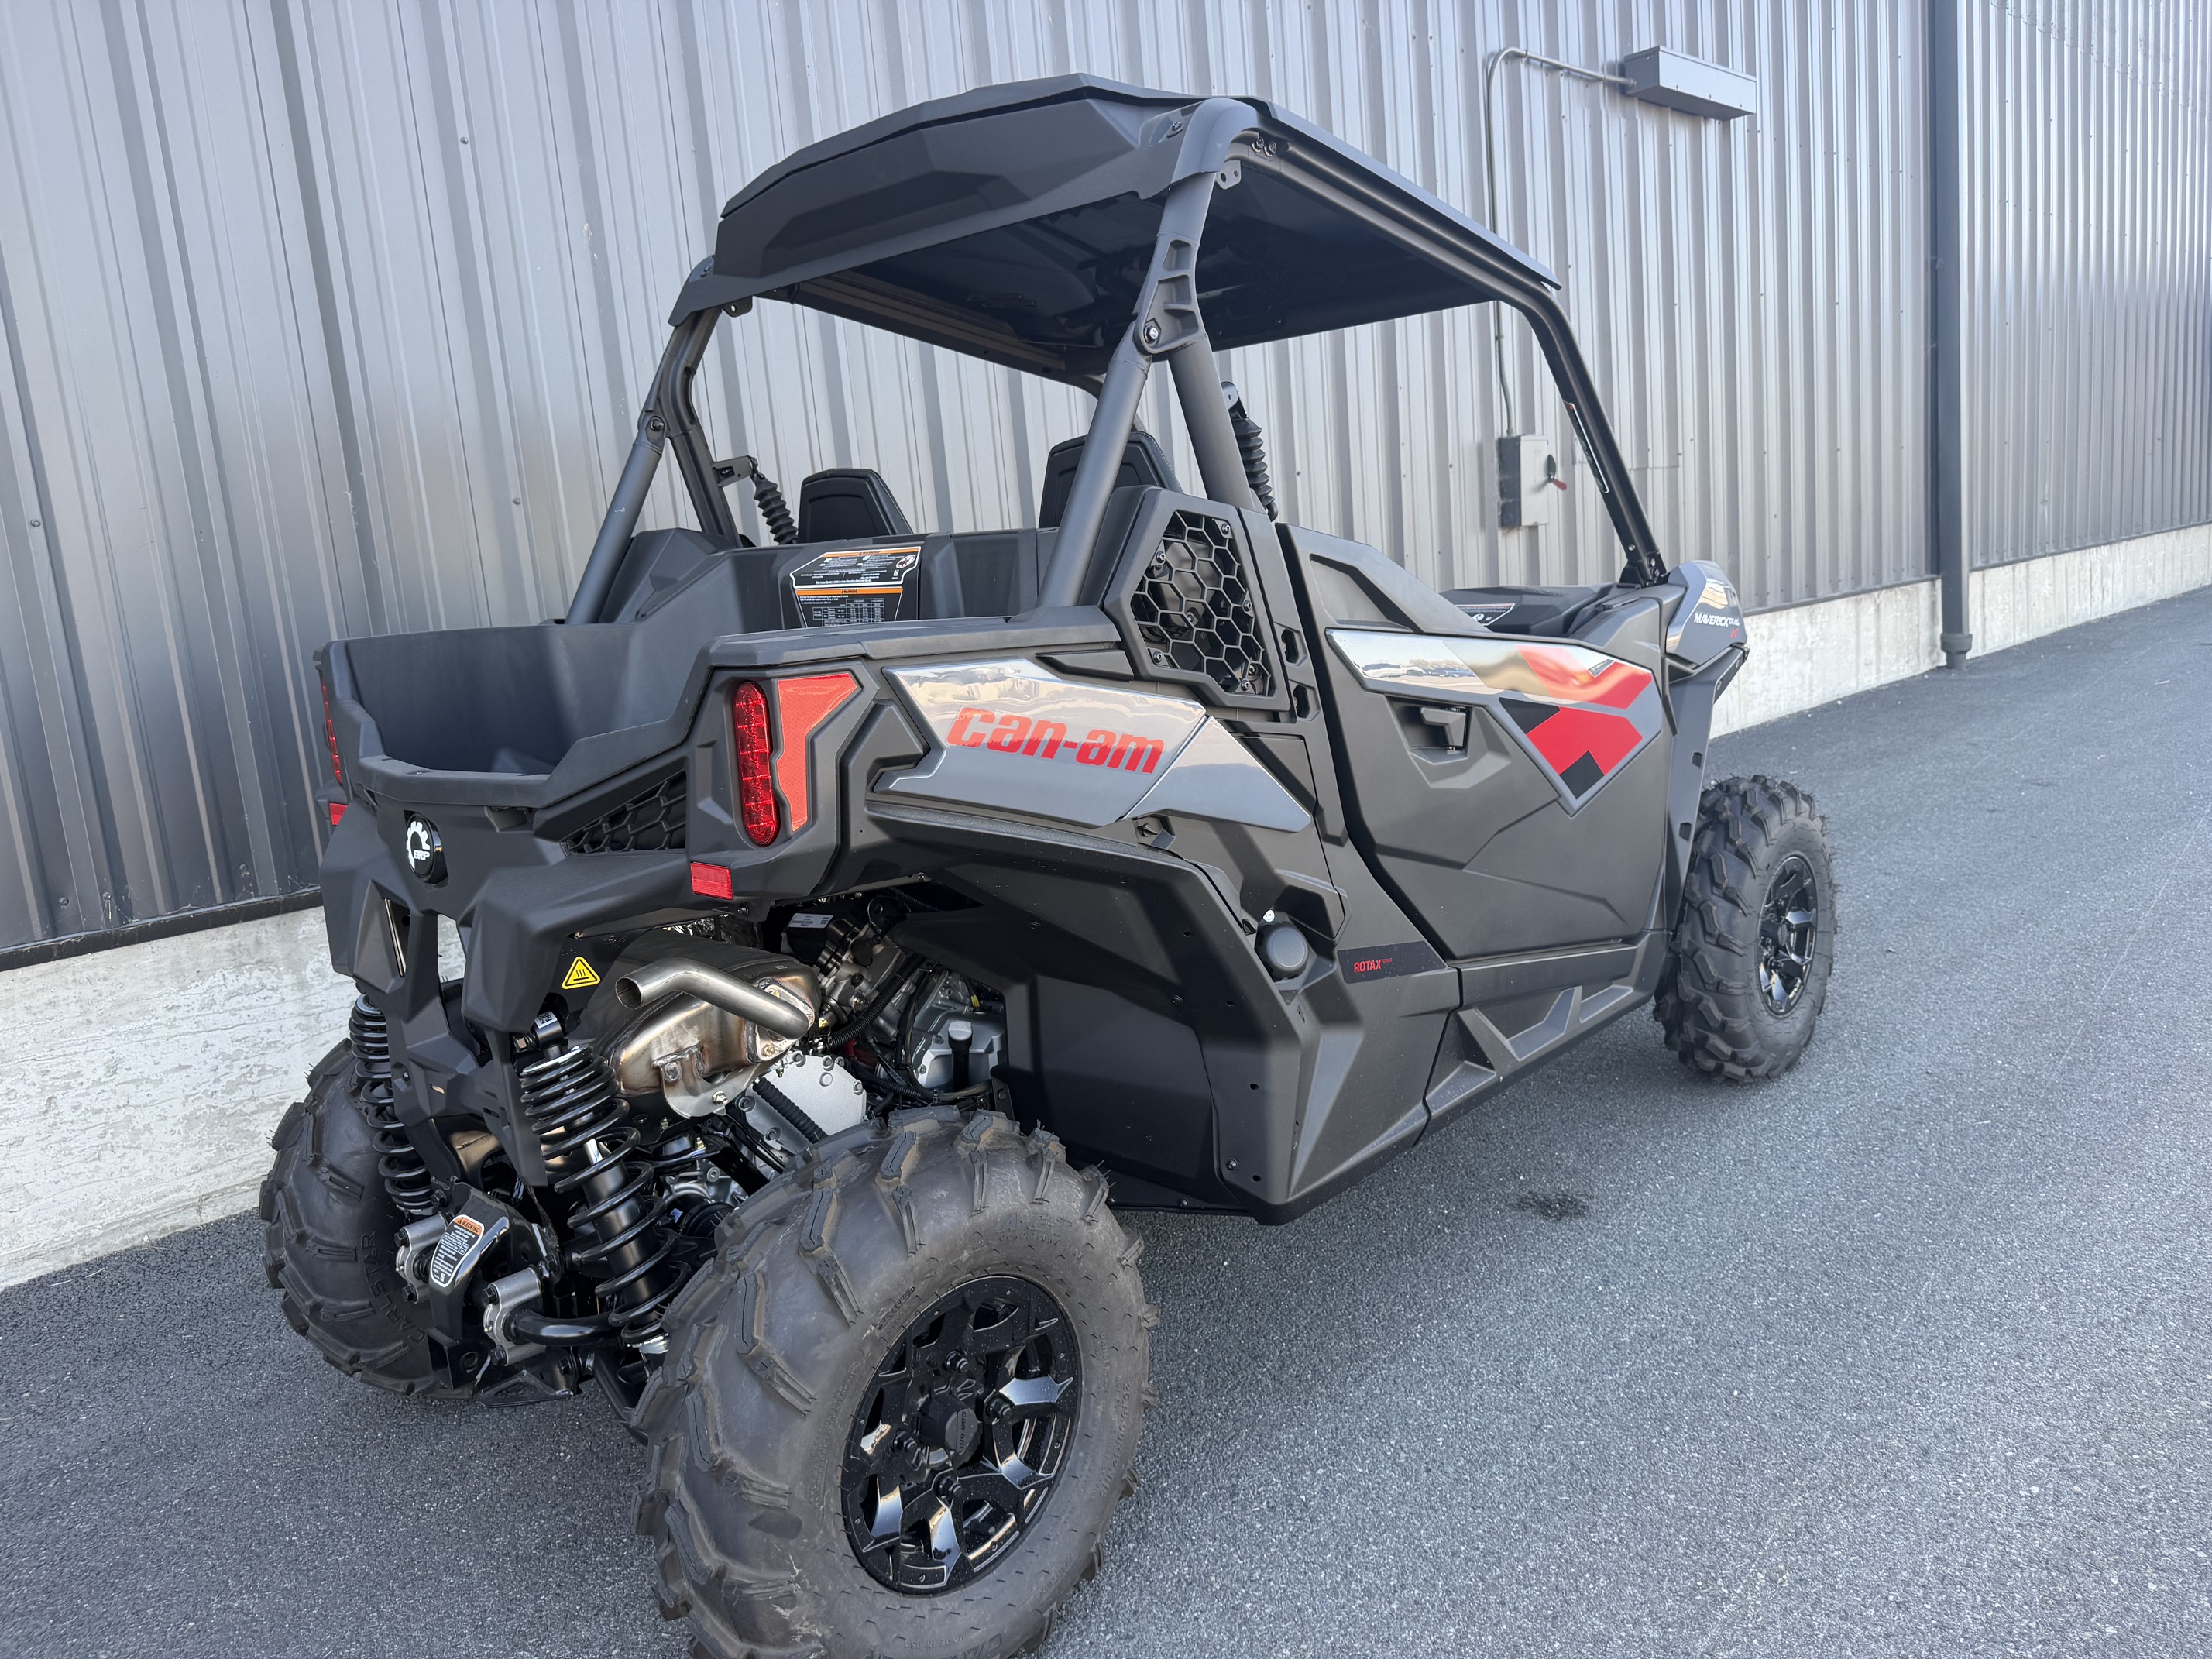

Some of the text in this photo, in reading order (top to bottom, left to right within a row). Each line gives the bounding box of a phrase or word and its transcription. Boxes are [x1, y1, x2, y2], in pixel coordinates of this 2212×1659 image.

[1694, 613, 1729, 627] MAVERICK
[414, 850, 430, 860] BRP
[1354, 960, 1382, 973] ROTAX
[462, 1220, 480, 1233] WARNING
